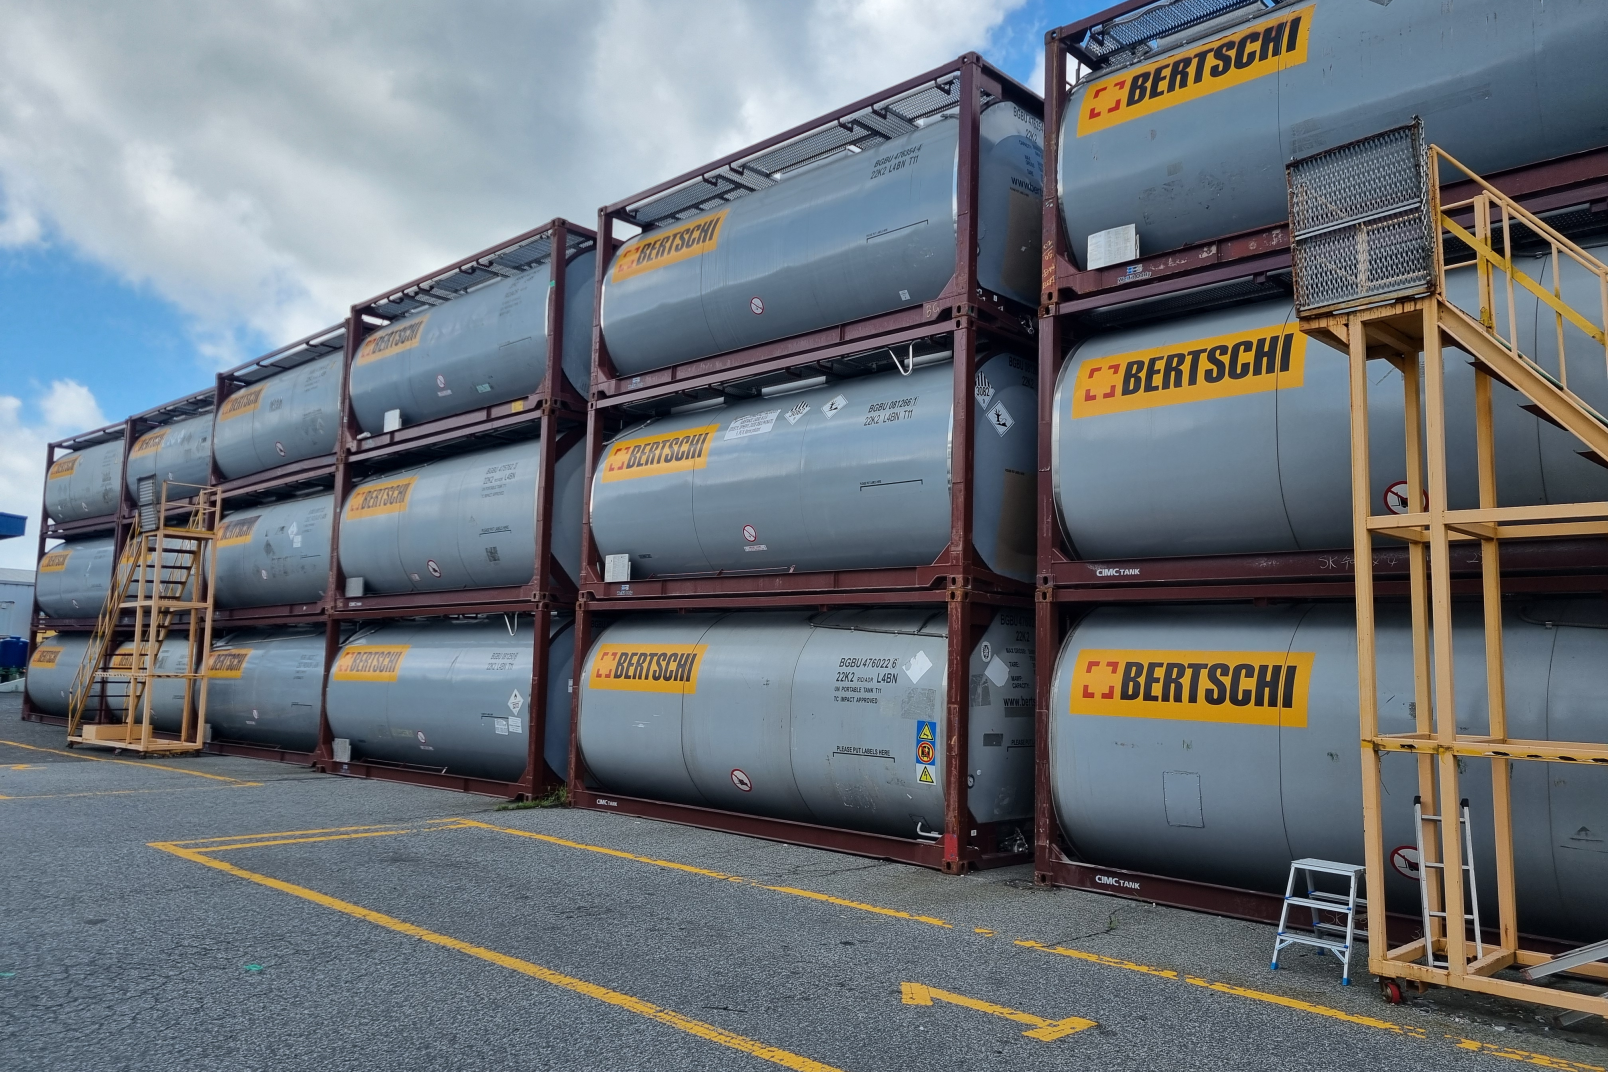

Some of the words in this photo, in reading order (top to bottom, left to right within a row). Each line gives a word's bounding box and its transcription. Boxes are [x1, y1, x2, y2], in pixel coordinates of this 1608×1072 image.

[1126, 17, 1302, 108] BERTSCHI
[870, 166, 887, 179] 22K2
[889, 159, 906, 173] L4BN
[636, 217, 721, 266] BERTSCHI
[371, 320, 423, 354] BERTSCHI
[1121, 333, 1294, 396] BERTSCHI
[976, 386, 990, 397] 3082
[864, 415, 881, 426] 22K2
[883, 411, 901, 423] L4BN
[903, 409, 914, 420] T11
[868, 402, 889, 413] BGBU
[626, 433, 709, 469] BERTSCHI
[361, 483, 410, 510] BERTSCHI
[1096, 568, 1120, 577] CIMC
[1120, 568, 1140, 576] TANK
[349, 652, 402, 672] BERTSCHI
[614, 652, 698, 682] BERTSCHI
[839, 657, 863, 668] BGBU
[862, 657, 891, 669] 476022
[836, 671, 855, 683] 22K2
[876, 672, 899, 684] L4BN
[1120, 662, 1297, 709] BERTSCHI
[1003, 695, 1036, 707] www.berts
[836, 745, 853, 753] PLEASE
[853, 746, 861, 754] PUT
[1095, 874, 1119, 886] CIMC
[1119, 879, 1141, 889] TANK
